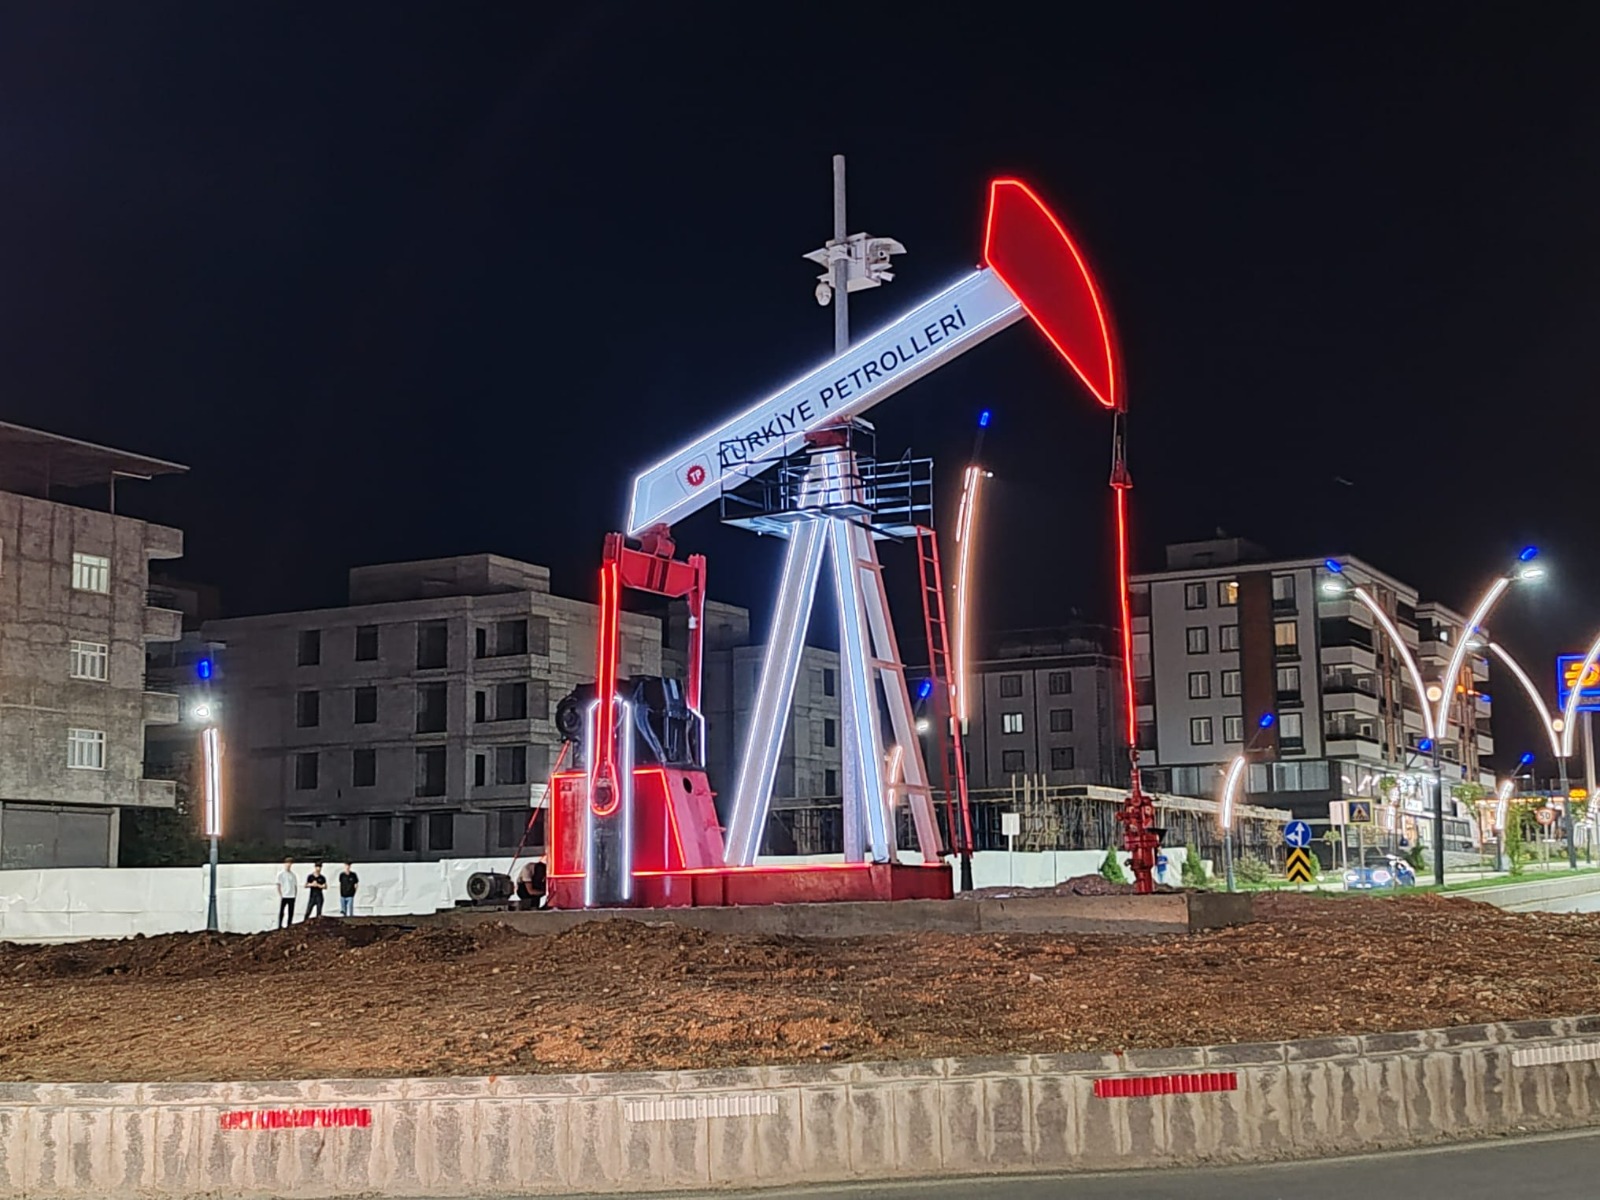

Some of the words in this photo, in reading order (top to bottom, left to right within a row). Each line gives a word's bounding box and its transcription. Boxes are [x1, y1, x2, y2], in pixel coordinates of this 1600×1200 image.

[716, 399, 815, 465] TÜRKİYE
[819, 304, 967, 408] PETROLLERİ
[1539, 811, 1551, 820] 50
